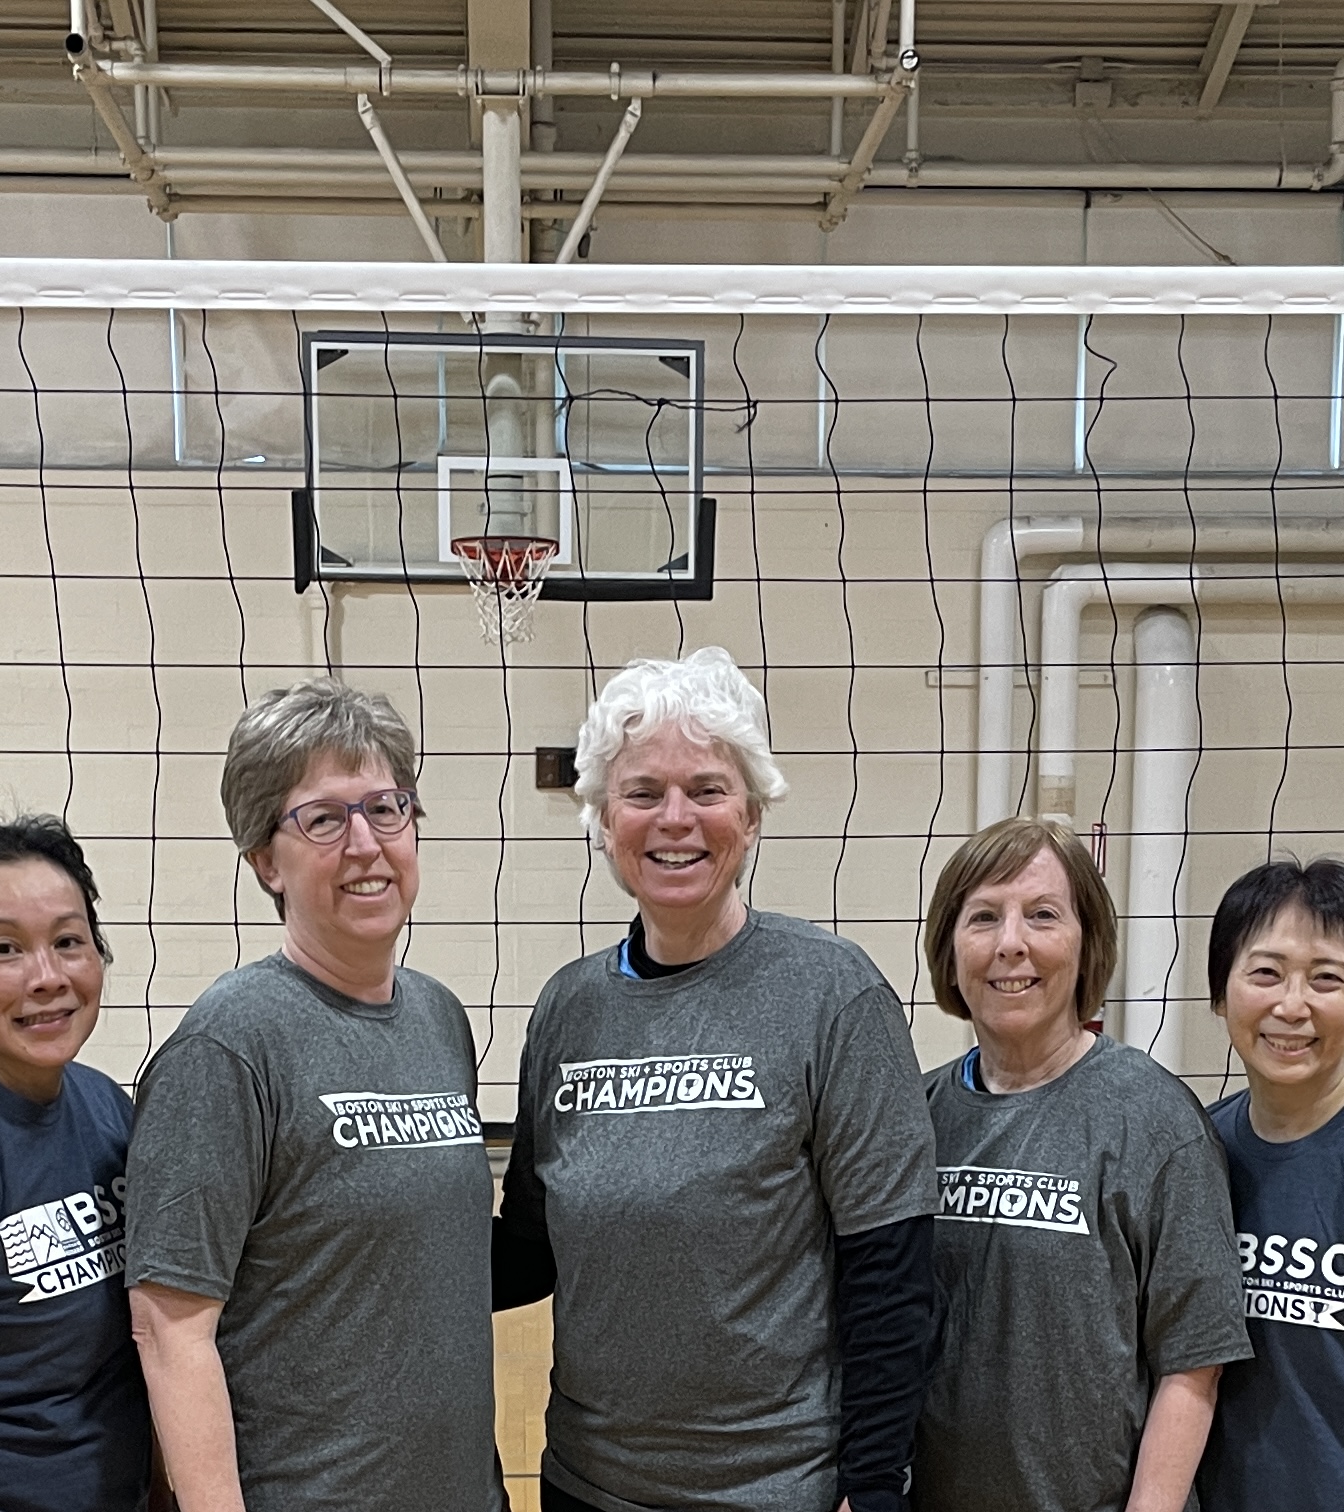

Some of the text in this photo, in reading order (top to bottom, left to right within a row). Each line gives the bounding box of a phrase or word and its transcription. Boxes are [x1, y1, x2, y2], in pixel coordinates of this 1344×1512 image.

[567, 1067, 616, 1082] BOSTON
[620, 1066, 640, 1079] SKI
[655, 1059, 709, 1075] SPORTS
[713, 1057, 753, 1070] CLUB
[554, 1070, 756, 1112] CHAMPIONS
[336, 1100, 383, 1115] BOSTON
[410, 1098, 447, 1112] SPORTS
[333, 1107, 481, 1148] CHAMPIONS
[977, 1173, 1034, 1188] SPORTS
[1036, 1177, 1080, 1192] CLUB
[940, 1185, 1082, 1223] MPIONS
[1283, 1281, 1322, 1295] SPORTS
